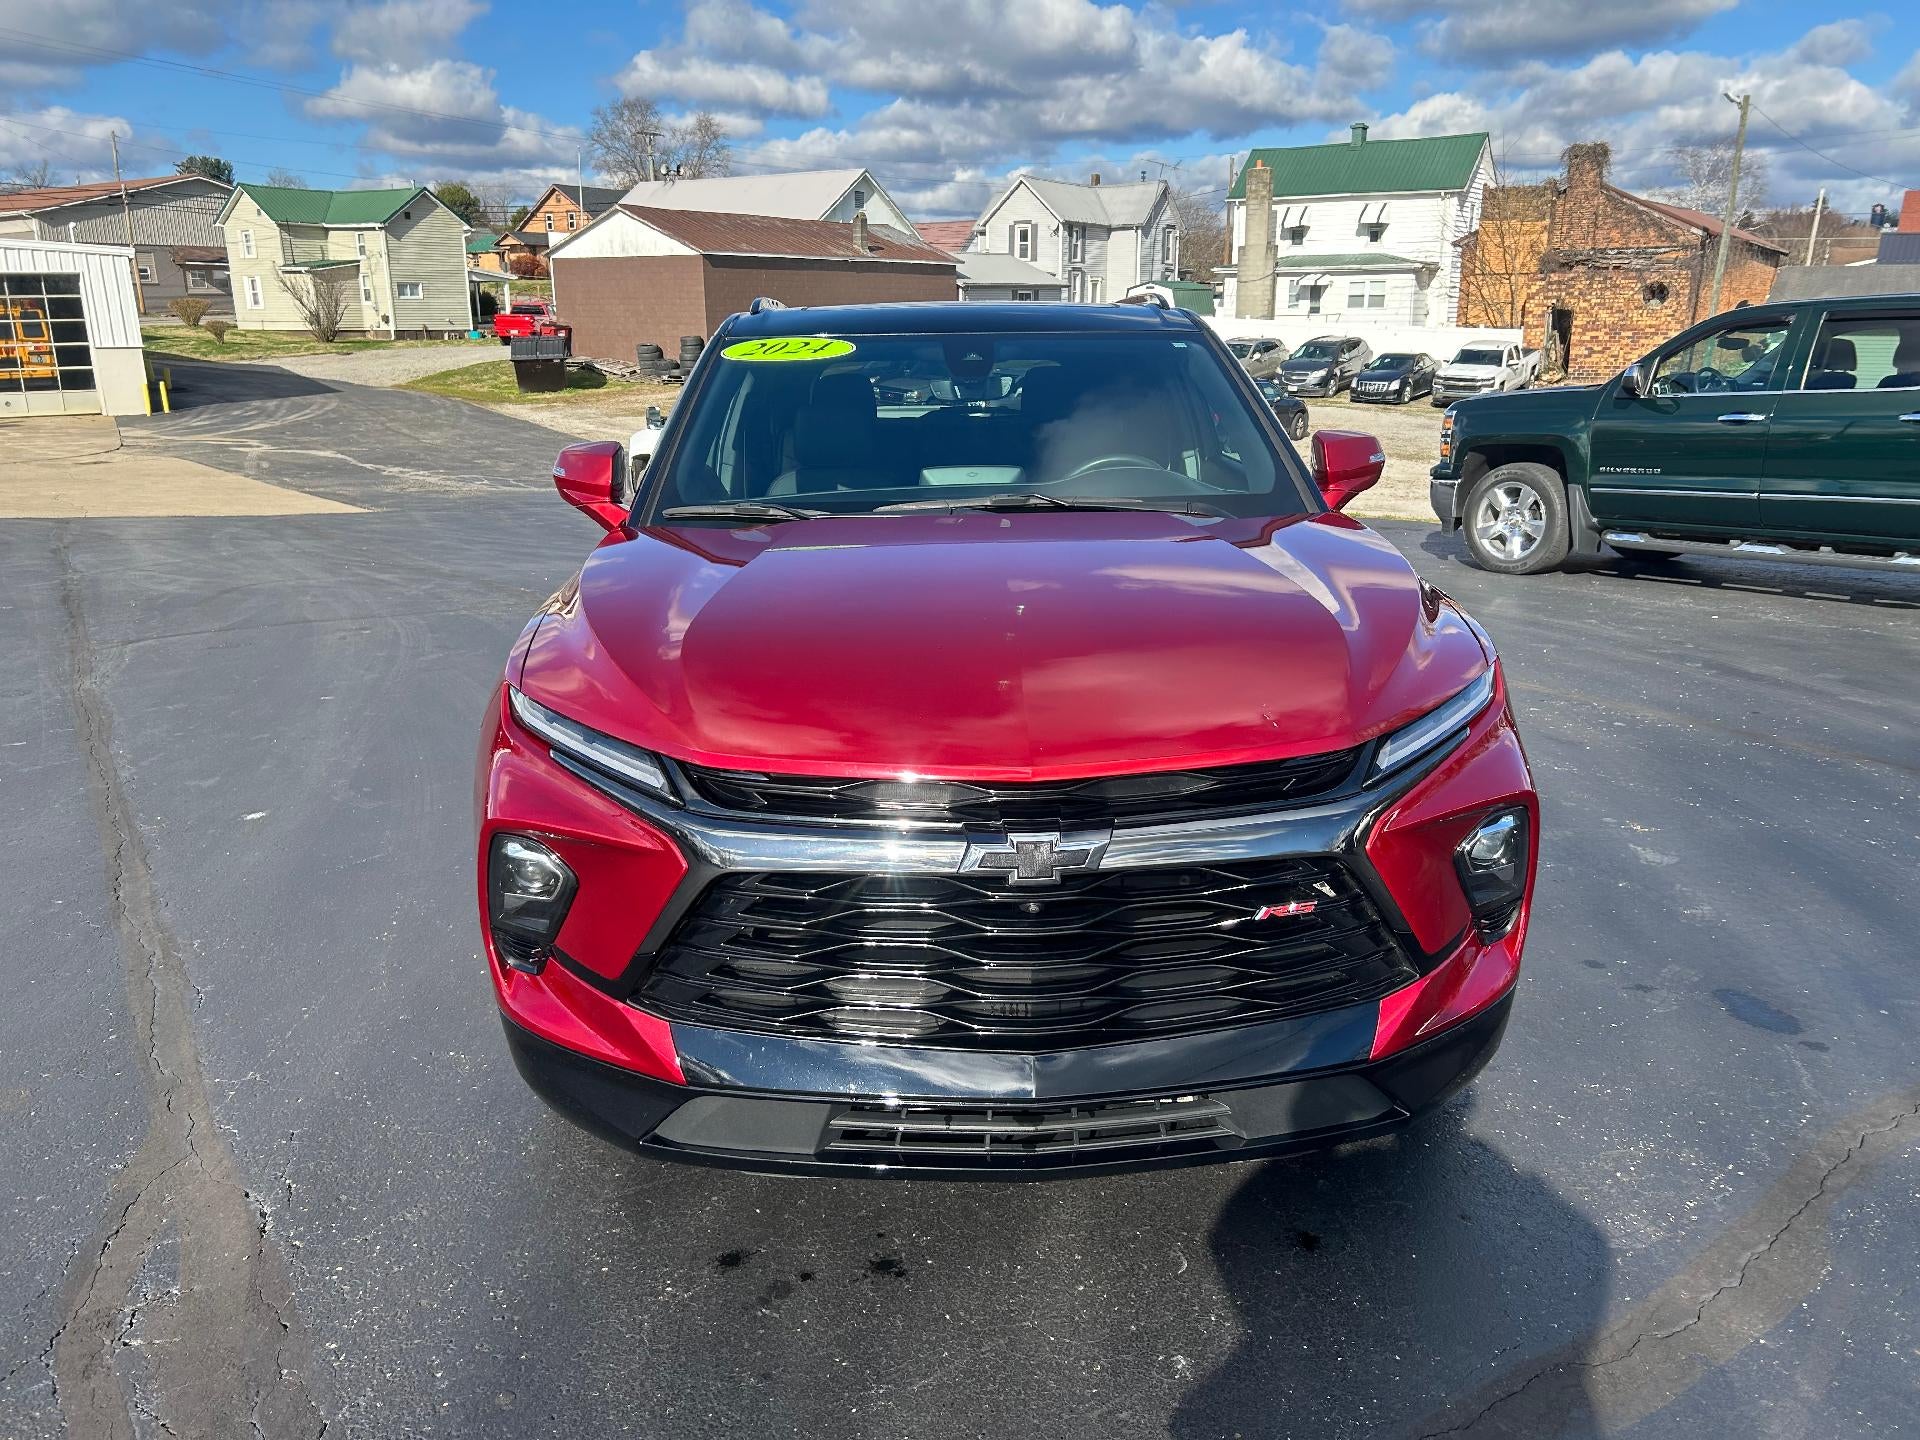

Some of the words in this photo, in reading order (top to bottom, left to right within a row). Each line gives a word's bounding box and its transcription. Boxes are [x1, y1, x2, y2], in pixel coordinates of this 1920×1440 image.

[738, 341, 834, 357] 2024
[1599, 466, 1661, 474] SILVERADO
[1252, 901, 1318, 920] RS
